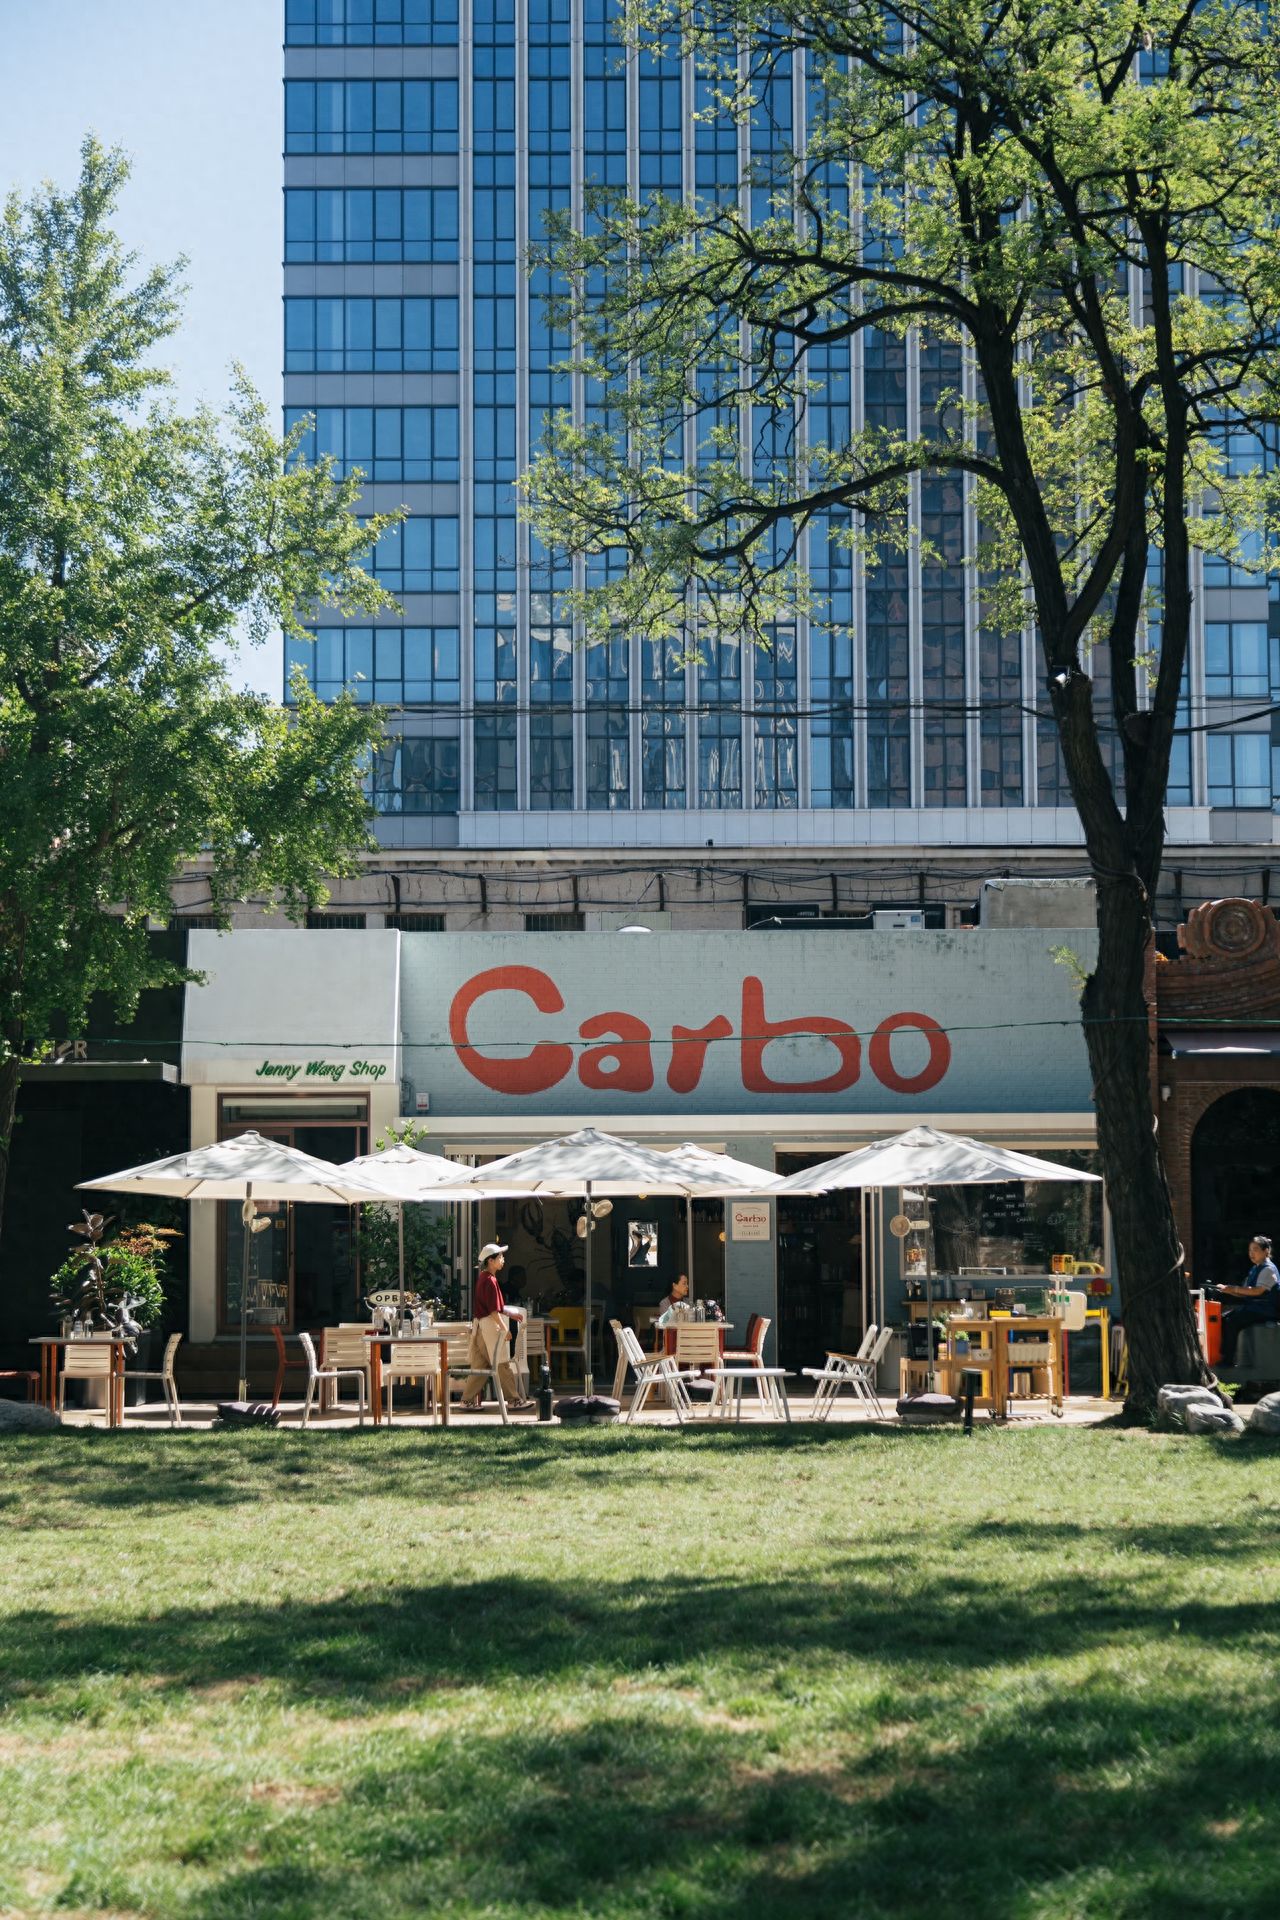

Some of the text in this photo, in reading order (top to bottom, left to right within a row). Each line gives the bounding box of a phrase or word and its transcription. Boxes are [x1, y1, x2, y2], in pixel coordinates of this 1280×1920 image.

[449, 965, 951, 1094] Carbo
[256, 1060, 386, 1081] Jenny Wang Shop
